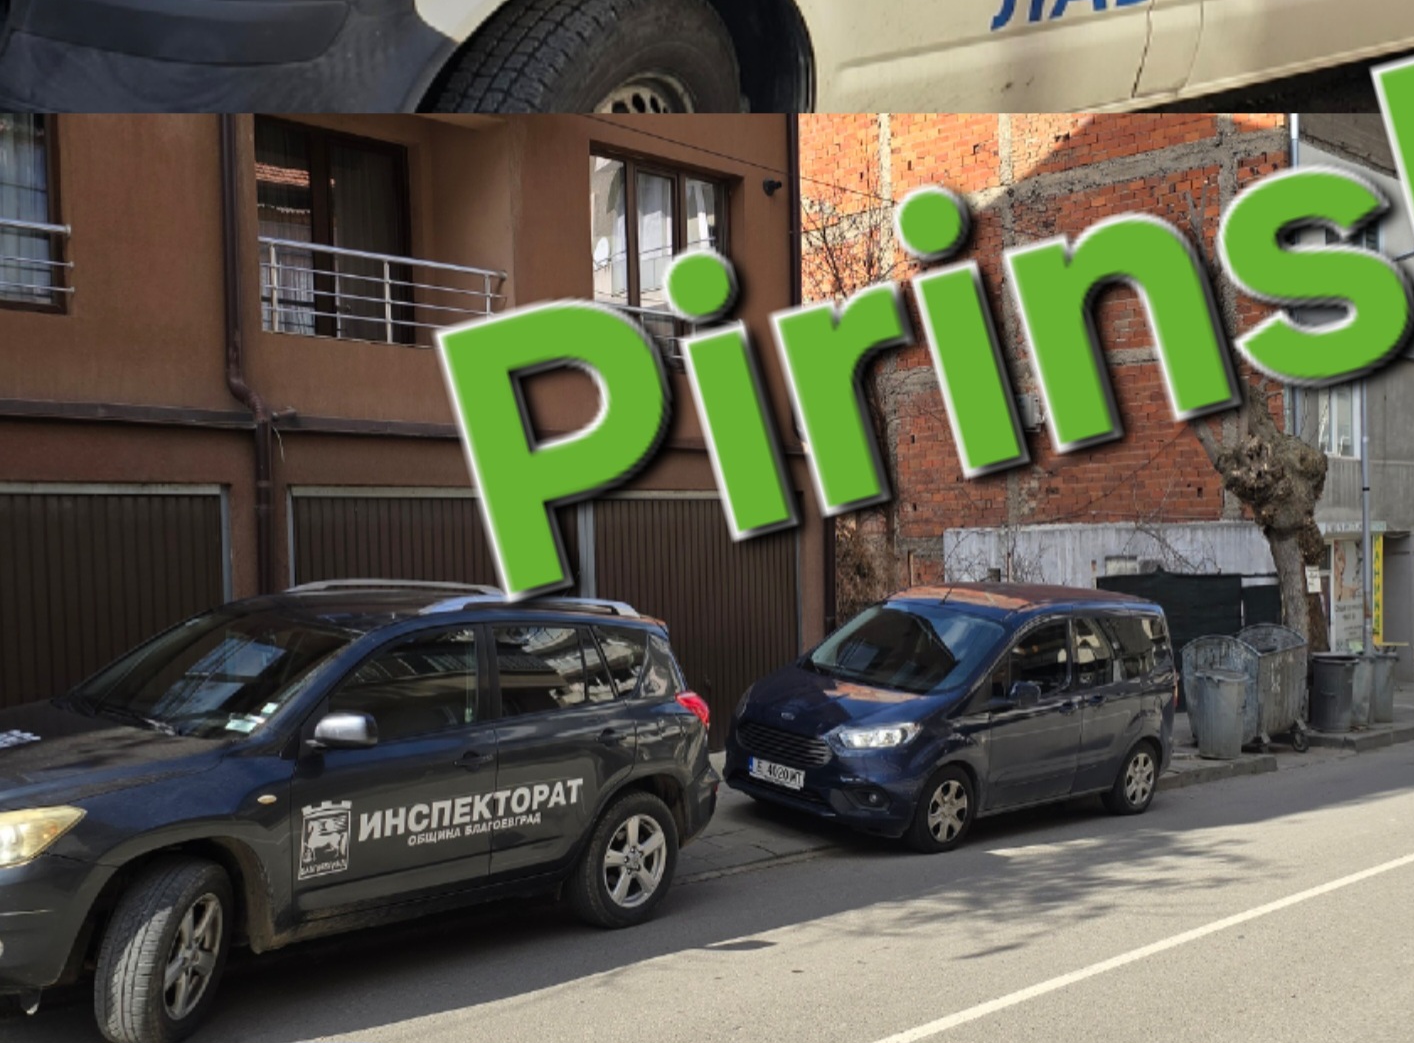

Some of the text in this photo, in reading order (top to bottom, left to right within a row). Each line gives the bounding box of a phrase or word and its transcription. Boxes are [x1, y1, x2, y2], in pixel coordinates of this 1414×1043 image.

[358, 778, 584, 842] ИНСПЕКТОРАТ
[407, 812, 542, 846] ОБЩИНА БЛАГОЕВГРАД
